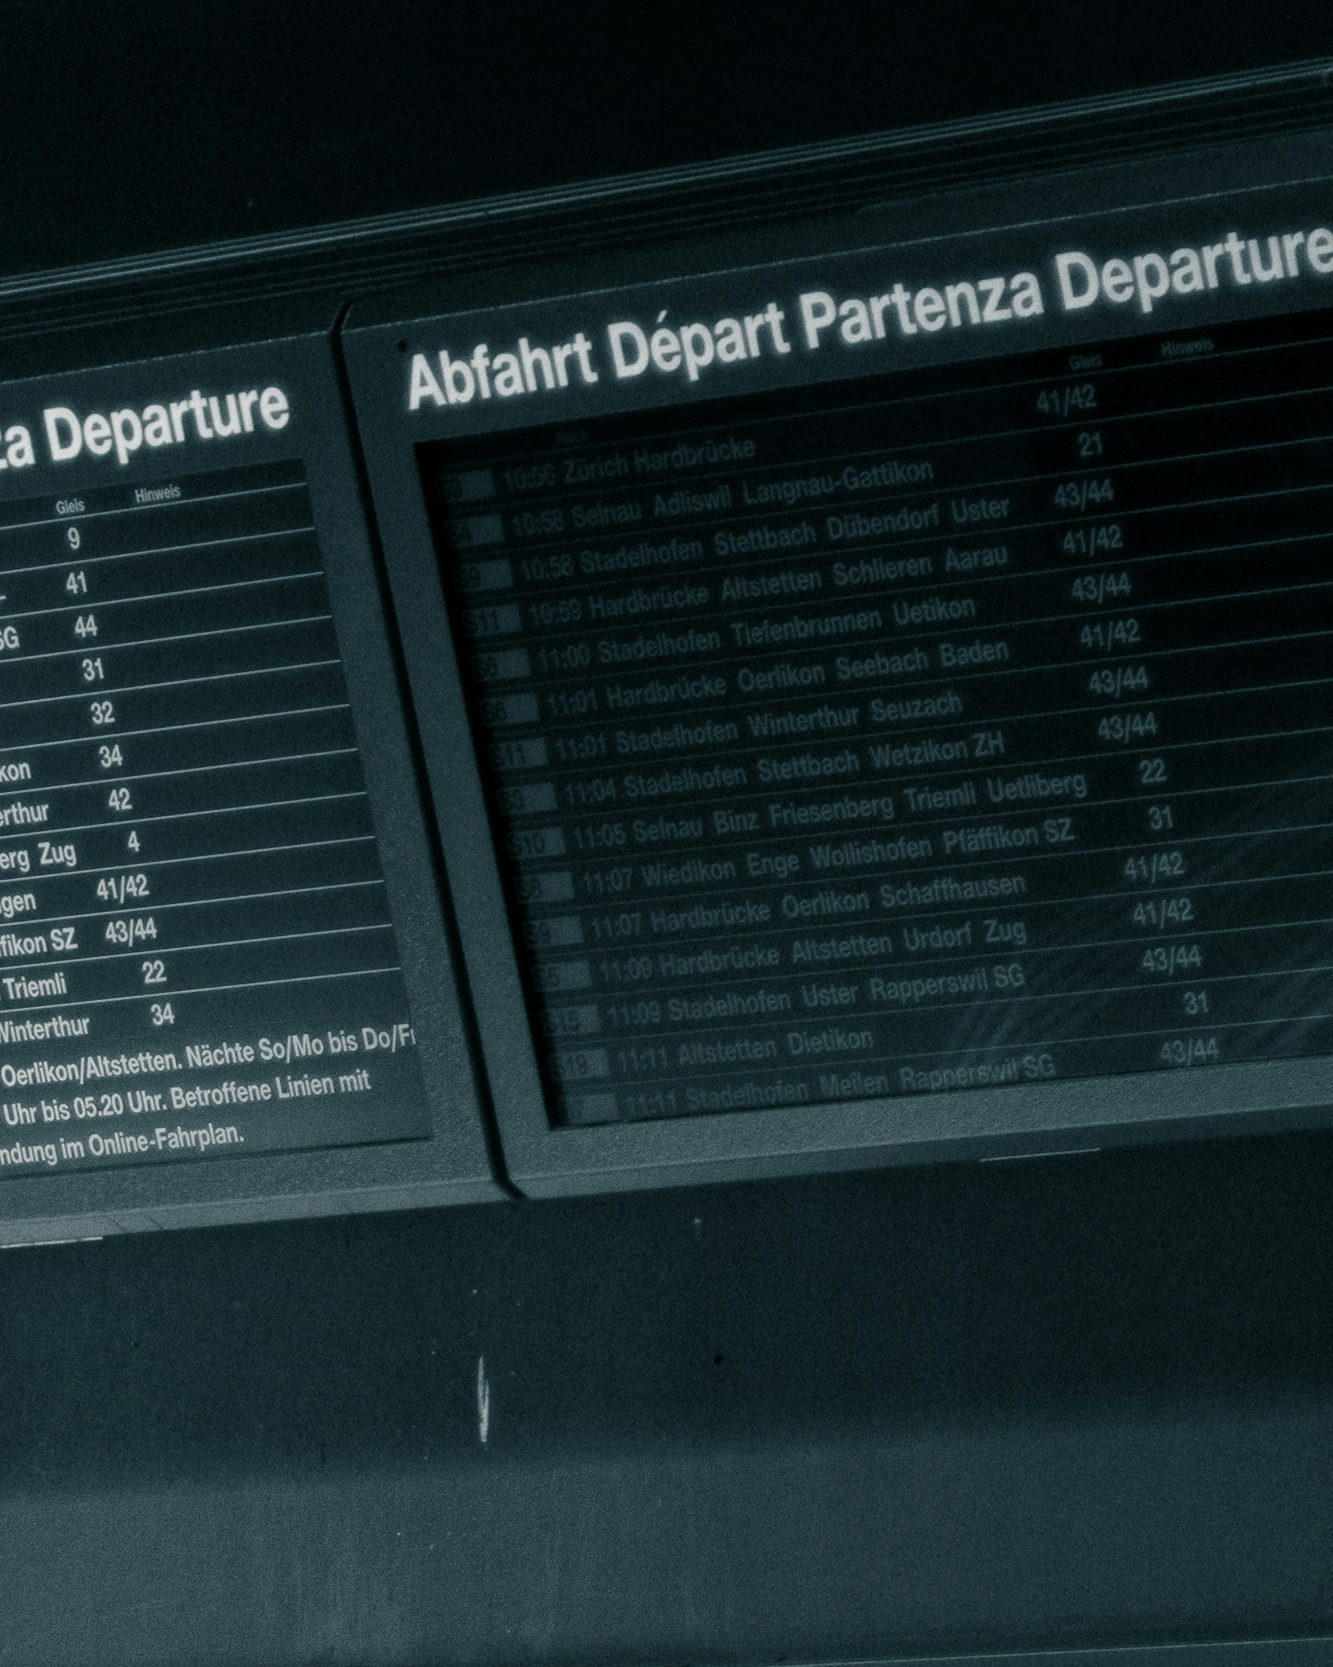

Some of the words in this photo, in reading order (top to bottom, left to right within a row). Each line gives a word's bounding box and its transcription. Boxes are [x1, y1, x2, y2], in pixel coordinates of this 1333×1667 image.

[407, 331, 600, 412] Abfahrt
[606, 301, 792, 383] Départ
[798, 271, 1046, 351] Partenza
[1054, 226, 1333, 314] Departure
[42, 385, 291, 466] Departure
[54, 499, 86, 516] Gleis
[133, 485, 182, 504] Hinweis
[1052, 476, 1116, 513] 43/44
[65, 525, 82, 551] 9
[64, 569, 89, 596] 41
[73, 613, 99, 639] 44
[80, 656, 106, 683] 31
[89, 699, 117, 726] 32
[36, 840, 78, 868] Zug
[126, 829, 142, 854] 4
[95, 872, 151, 905] 41/42
[48, 925, 80, 952] SZ
[104, 916, 159, 948] 43/44
[1, 970, 69, 1001] Triemli
[140, 958, 169, 986] 22
[0, 1051, 184, 1088] Oerlikon/Altstetten.
[184, 1041, 256, 1069] Nächte
[257, 1032, 325, 1065] So/Mo
[326, 1029, 360, 1055] bis
[1, 1101, 38, 1127] Uhr
[39, 1098, 72, 1123] bis
[72, 1091, 125, 1120] 05.20
[125, 1089, 169, 1114] Uhr.
[169, 1079, 273, 1110] Betroffene
[274, 1072, 336, 1100] Linien
[337, 1067, 373, 1094] mit
[58, 1136, 86, 1160] im
[87, 1121, 246, 1157] Online-Fahrplan.
